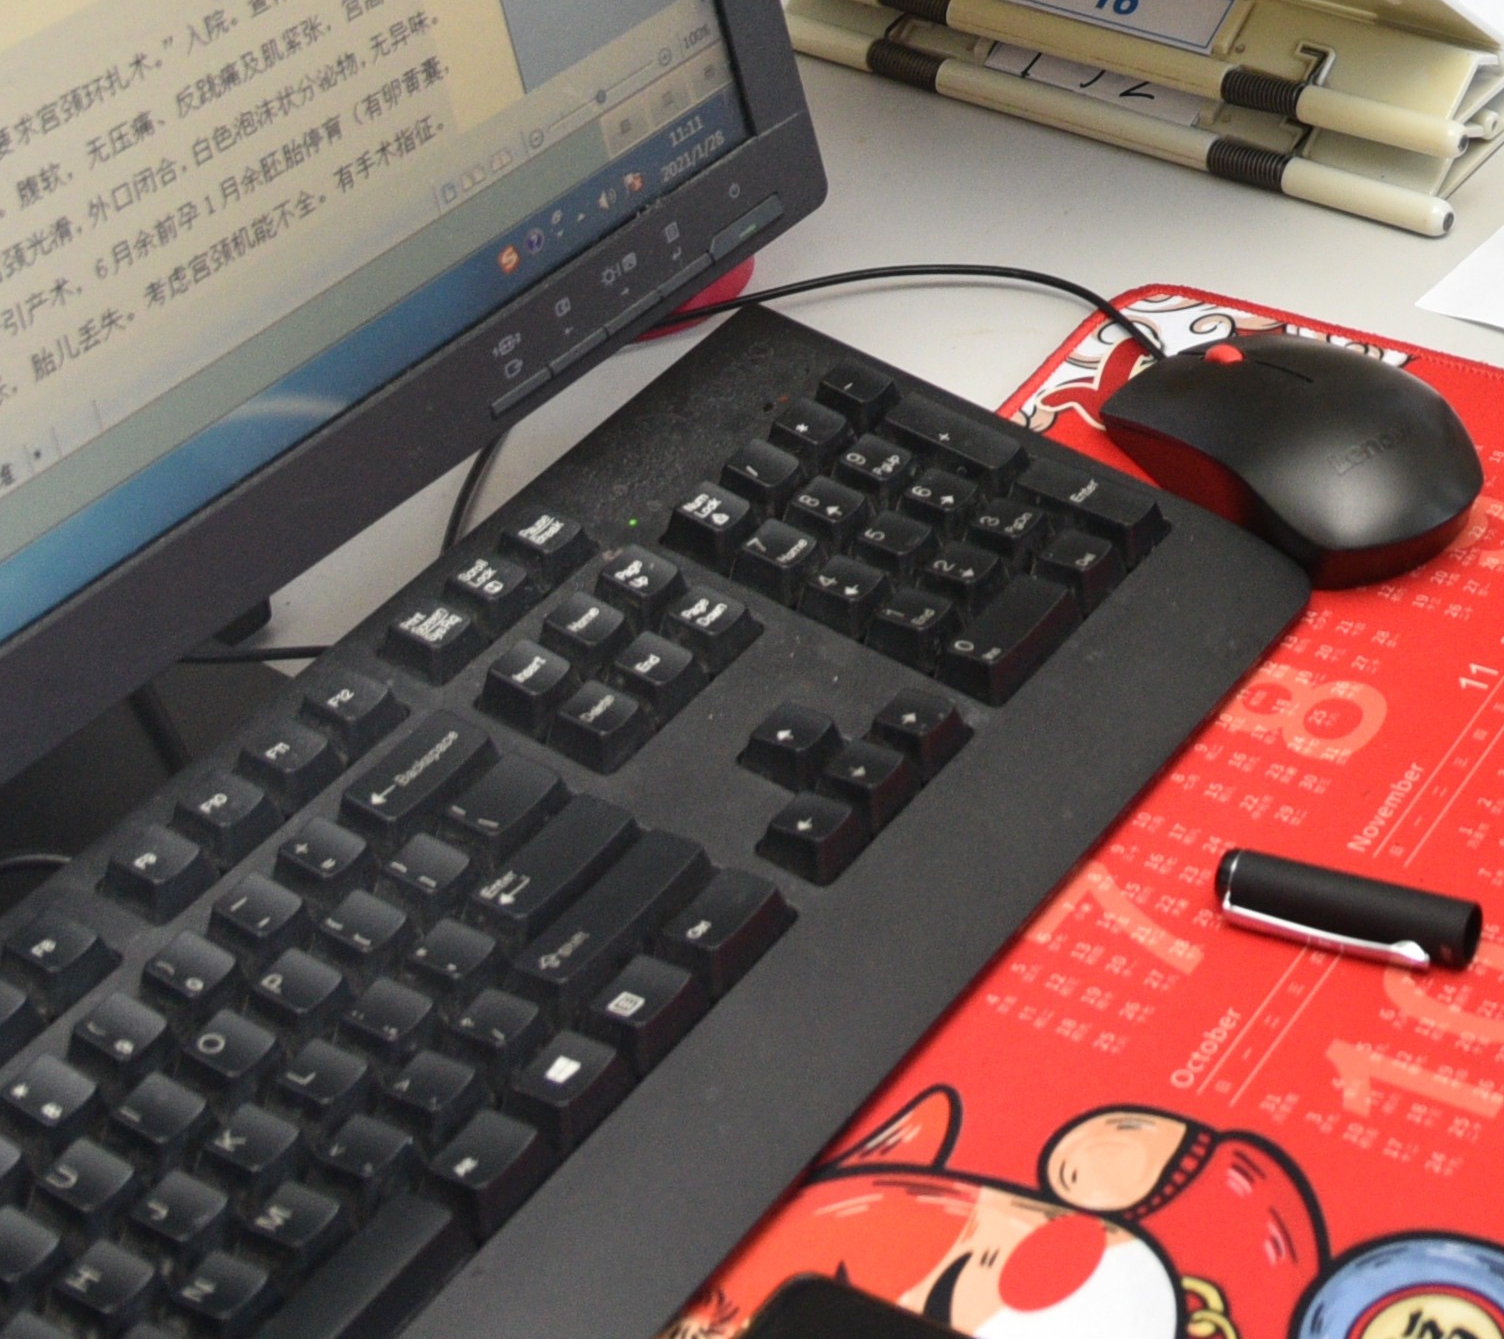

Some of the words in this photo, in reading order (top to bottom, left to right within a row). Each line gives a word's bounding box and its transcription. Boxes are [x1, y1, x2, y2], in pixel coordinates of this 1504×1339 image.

[668, 116, 704, 148] 11:11
[660, 131, 726, 183] 2021/1/28
[911, 485, 932, 498] 6
[1069, 479, 1098, 504] Enter
[694, 497, 721, 518] Lock
[864, 528, 886, 541] 5
[777, 538, 808, 563] Home
[614, 559, 643, 581] Page
[932, 559, 955, 573] 2
[629, 575, 649, 588] Up
[818, 574, 837, 588] 4
[568, 606, 600, 632] Home
[681, 598, 710, 619] Page
[696, 602, 728, 627] Down
[953, 639, 975, 652] 0
[512, 655, 547, 683] Insert
[634, 653, 661, 673] End
[327, 688, 355, 708] F12
[580, 694, 615, 722] Delete
[394, 730, 459, 786] Backspace
[1346, 760, 1424, 852] November
[1455, 663, 1499, 689] 11
[199, 793, 228, 814] F10
[260, 973, 283, 994] P
[1167, 1005, 1243, 1088] October
[215, 1129, 245, 1151] K
[46, 1163, 78, 1188] U
[255, 1205, 291, 1230] M
[67, 1264, 100, 1291] H
[181, 1278, 215, 1302] N
